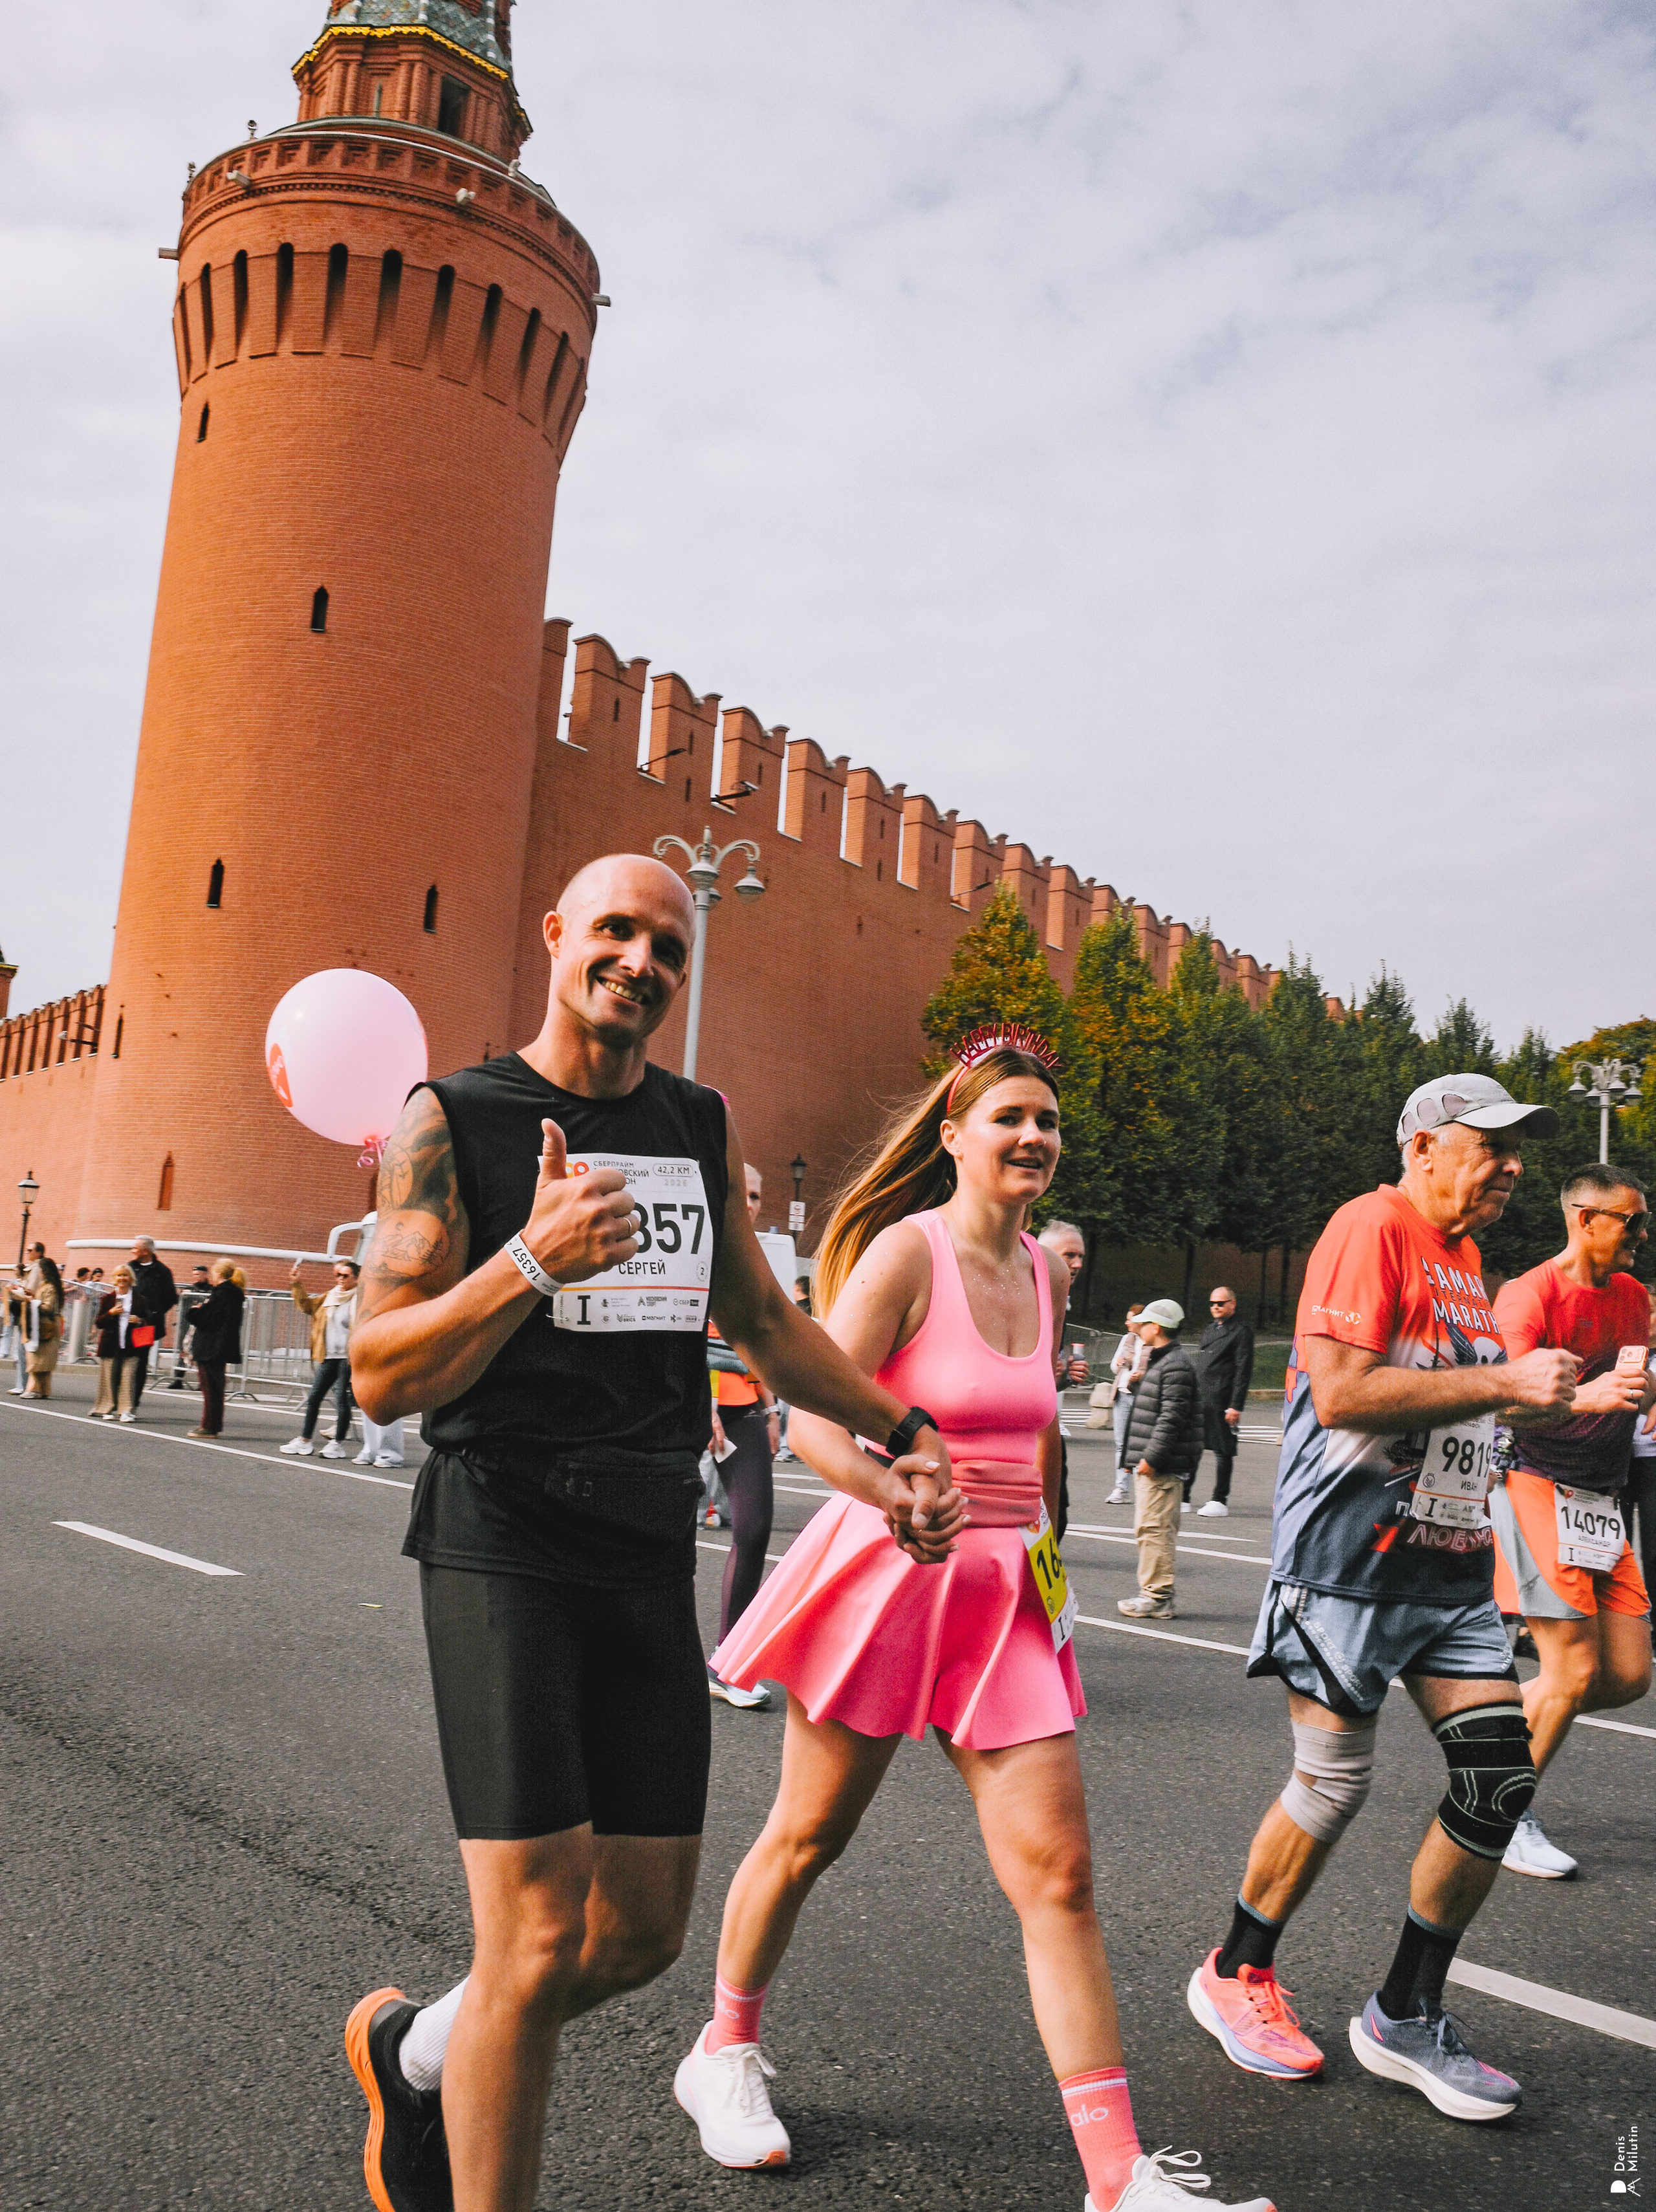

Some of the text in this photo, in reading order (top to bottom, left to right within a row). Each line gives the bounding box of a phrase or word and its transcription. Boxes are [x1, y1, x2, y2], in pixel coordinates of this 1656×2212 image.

[950, 1022, 1062, 1069] HAPPY BIRTHDAY
[634, 1202, 705, 1254] 357
[512, 1248, 541, 1280] 16357
[618, 1259, 666, 1275] СЕРГЕЙ
[1561, 1506, 1620, 1540] 14079
[1314, 1622, 1336, 1649] SPORT
[1070, 2104, 1109, 2127] alo
